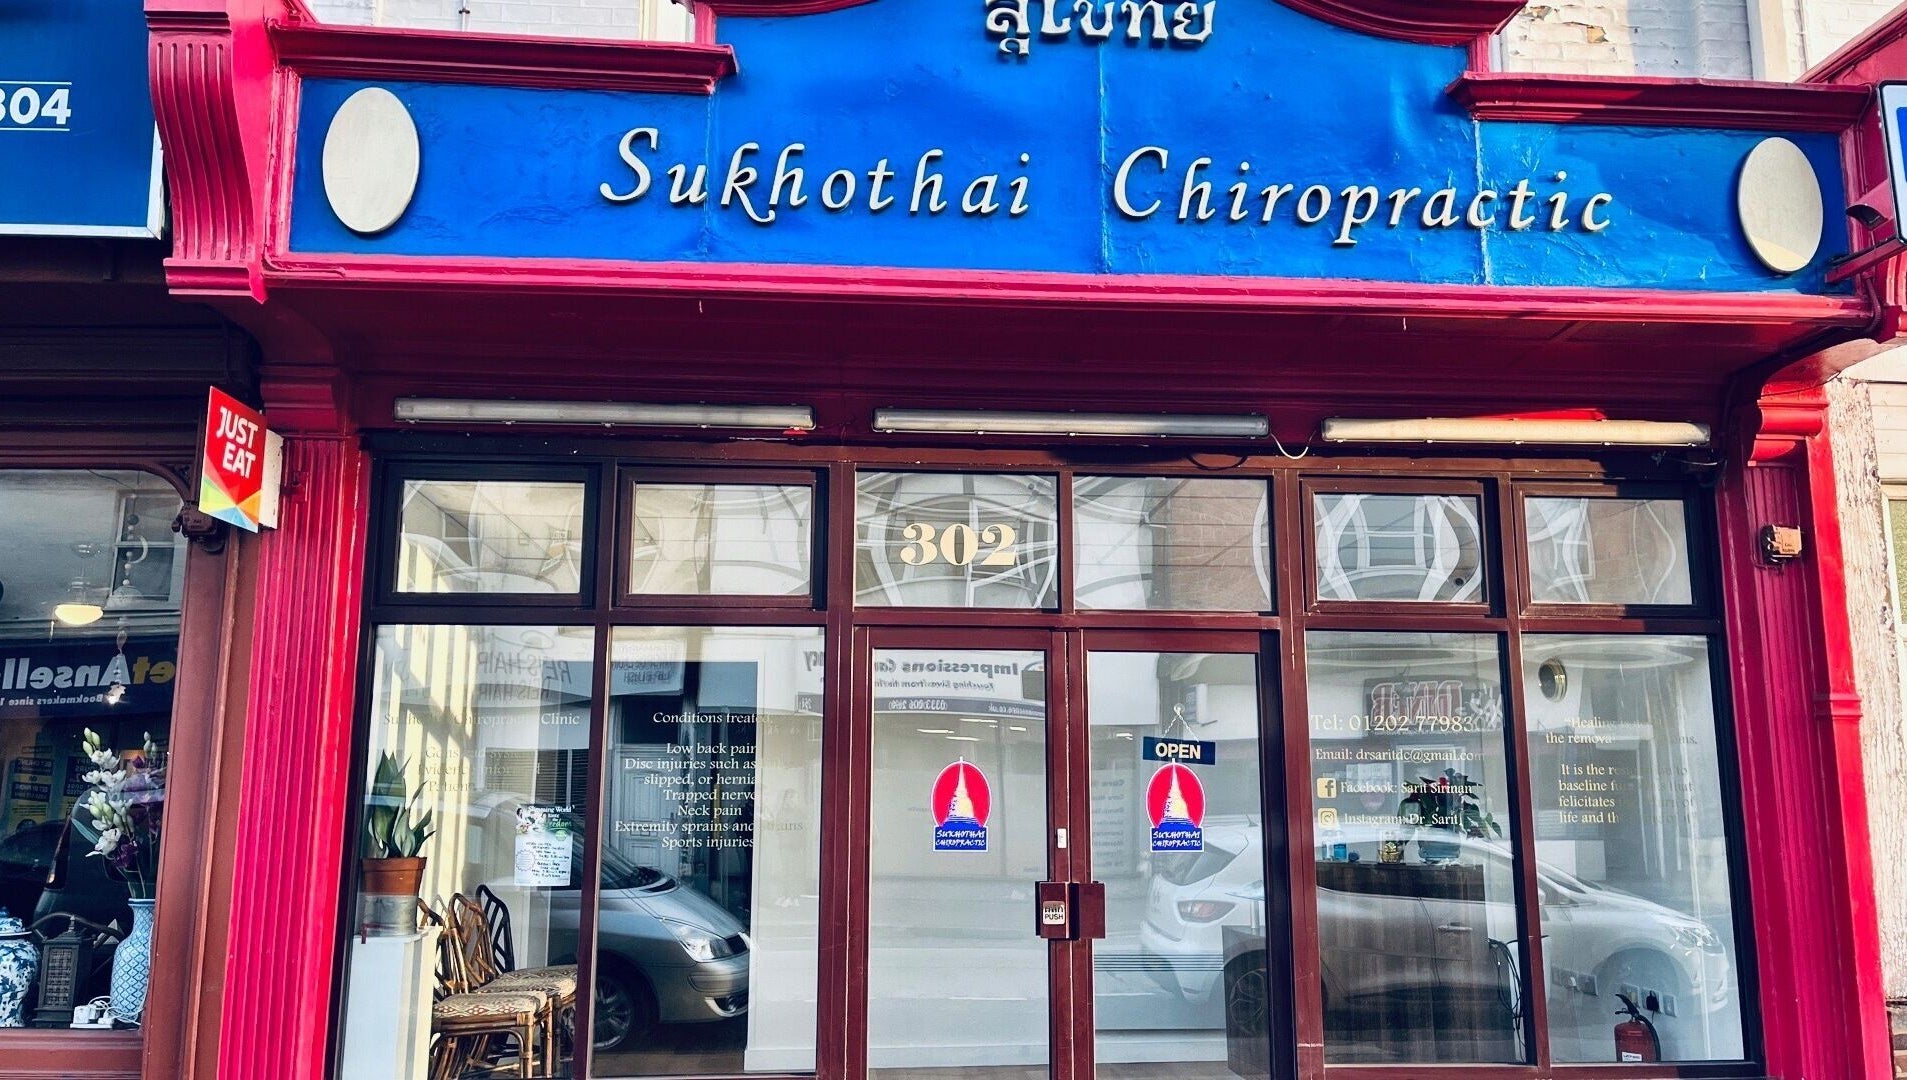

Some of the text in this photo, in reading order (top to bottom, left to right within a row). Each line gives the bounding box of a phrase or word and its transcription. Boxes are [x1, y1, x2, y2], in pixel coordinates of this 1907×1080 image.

[0, 86, 72, 125] 04
[599, 127, 1614, 247] Sukhothai Chiropractic
[216, 405, 259, 449] JUST
[222, 442, 257, 479] EAT
[899, 523, 1017, 566] 302
[540, 713, 581, 726] Clinic
[653, 711, 723, 724] Conditions
[1311, 714, 1343, 730] Tel:
[1348, 716, 1409, 732] 01202
[1545, 733, 1565, 744] the
[666, 742, 692, 754] Low
[697, 741, 727, 754] back
[1155, 742, 1201, 760] OPEN
[1315, 749, 1353, 761] Email:
[625, 757, 653, 770] Disc
[657, 757, 706, 772] injuries
[709, 757, 739, 769] such
[1560, 763, 1569, 775] It
[1574, 763, 1583, 775] is
[1586, 763, 1606, 775] the
[643, 773, 695, 787] slipped,
[698, 776, 713, 785] or
[1558, 779, 1607, 791] baseline
[1340, 782, 1398, 794] Facebook:
[1401, 781, 1429, 794] Sarit
[662, 788, 717, 802] Trapped
[1559, 795, 1616, 808] felicitates
[677, 804, 742, 819] Neck pain
[1560, 811, 1577, 824] life
[1581, 811, 1604, 824] and
[615, 820, 678, 834] Extremity
[681, 820, 729, 835] sprains
[936, 829, 986, 839] SUKHOTHAI
[1152, 829, 1201, 839] SUKHOTHAI
[661, 837, 703, 850] Sports
[935, 838, 986, 848] CHIROPRACTIC
[1151, 838, 1202, 848] CHIROPRACTIC
[1044, 913, 1064, 921] PUSH
